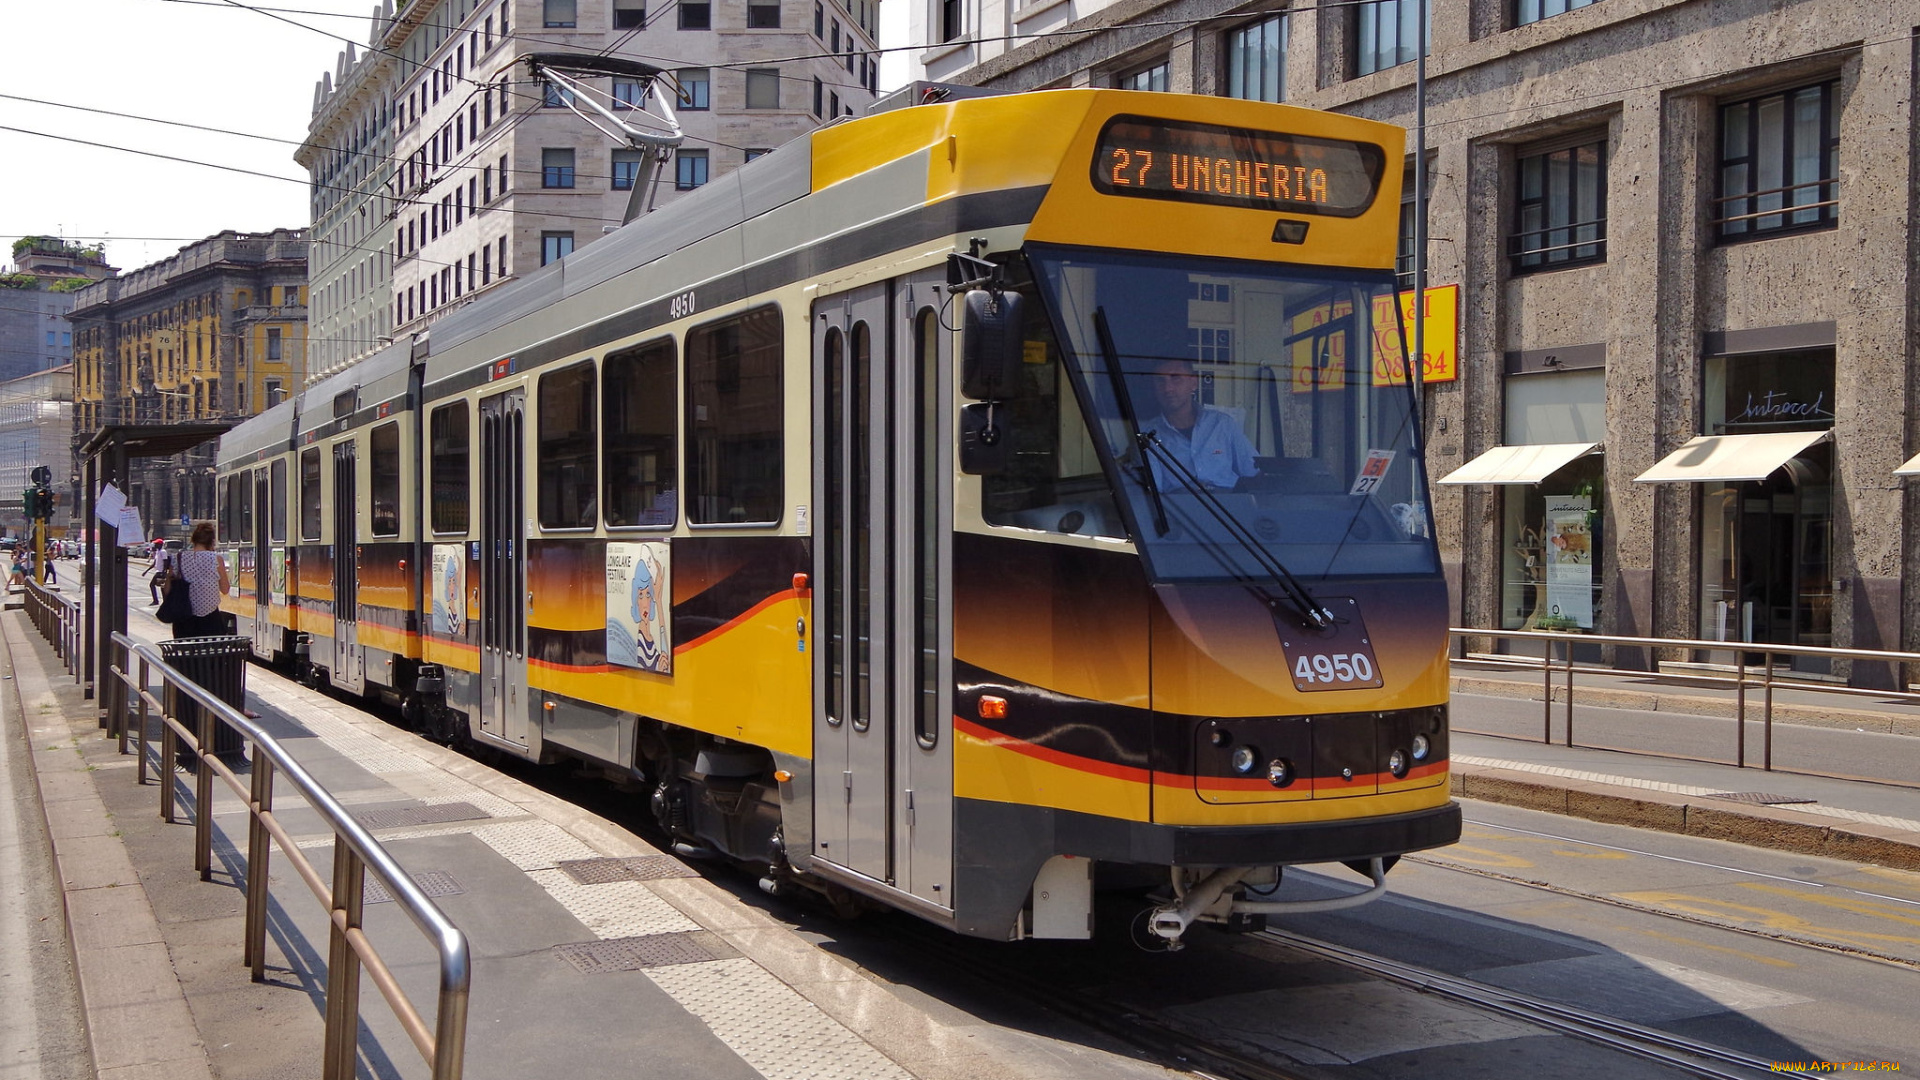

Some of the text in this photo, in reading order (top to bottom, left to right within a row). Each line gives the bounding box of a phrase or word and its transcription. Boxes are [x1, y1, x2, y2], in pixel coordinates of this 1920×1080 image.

[1112, 148, 1327, 202] 27 UNGHERIA
[670, 291, 695, 319] 4950
[159, 336, 170, 344] 76
[1356, 477, 1378, 493] 27
[607, 555, 631, 568] LONGLAKE
[607, 568, 627, 580] FESTIVAL
[1295, 652, 1373, 683] 4950
